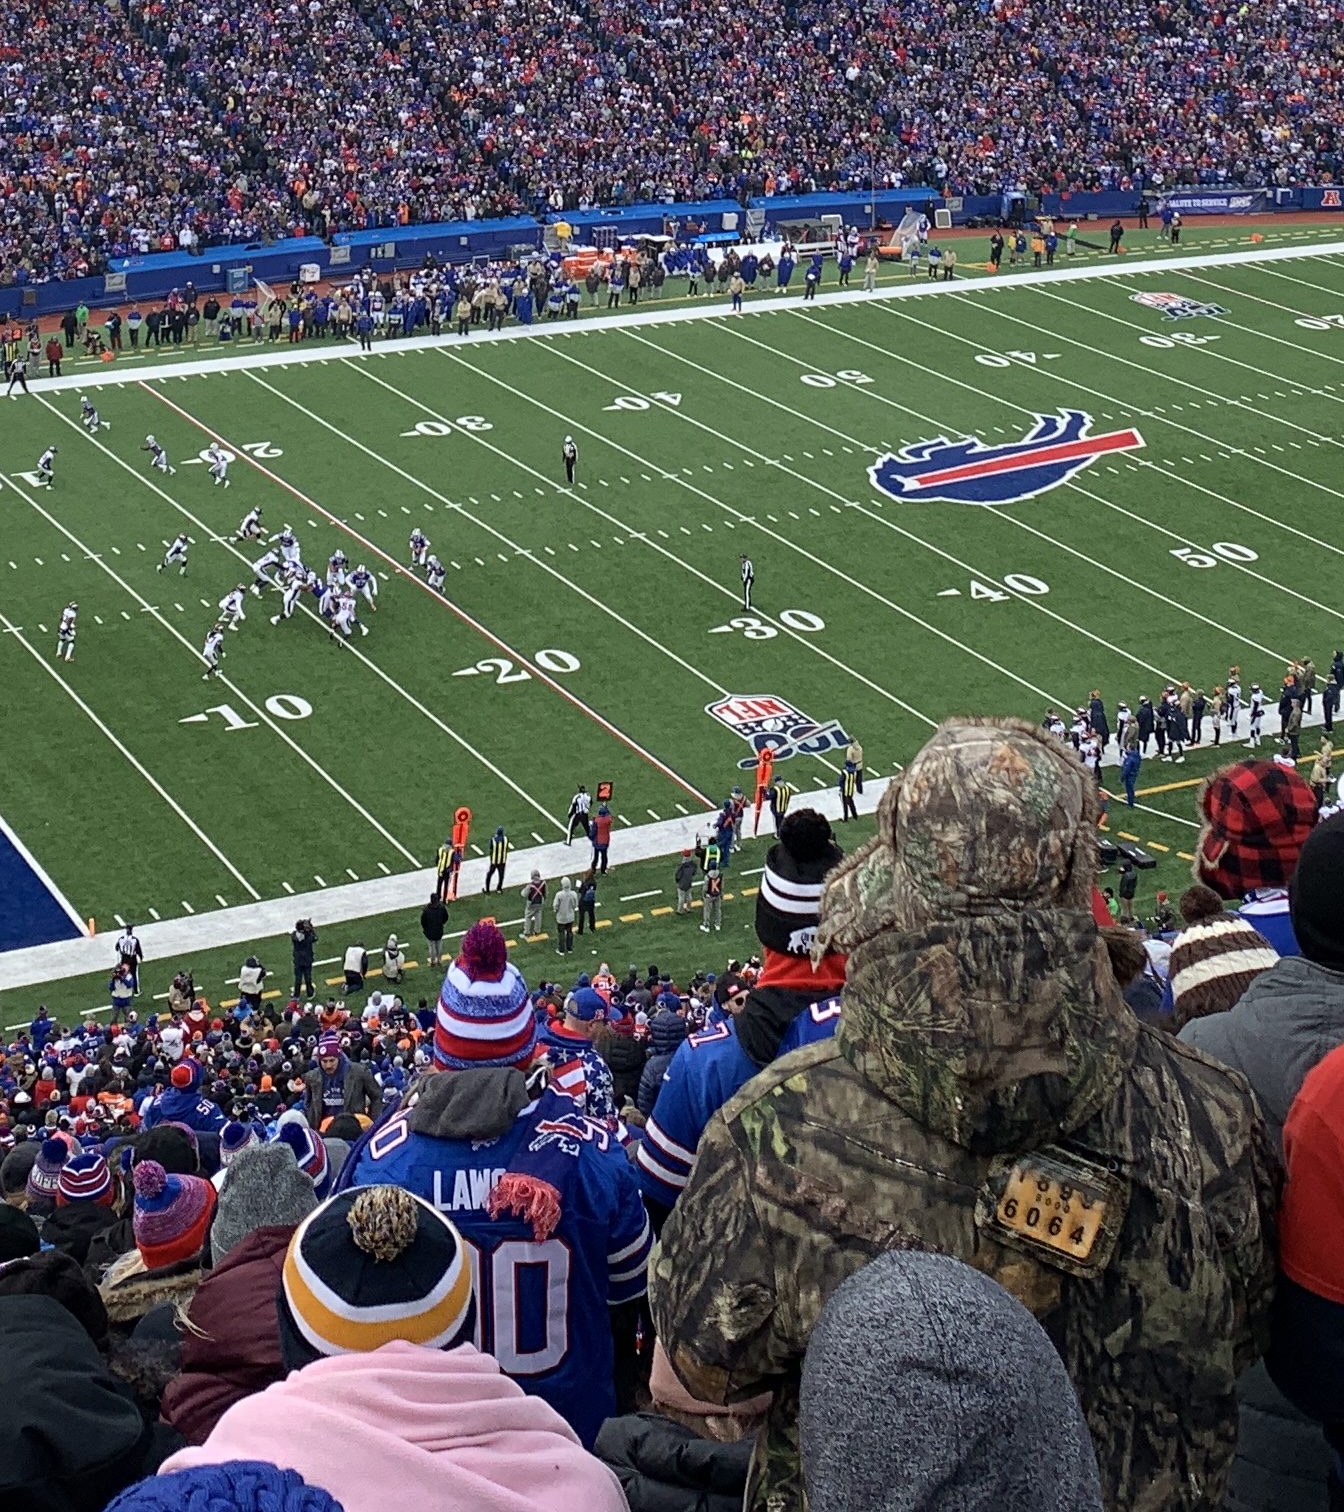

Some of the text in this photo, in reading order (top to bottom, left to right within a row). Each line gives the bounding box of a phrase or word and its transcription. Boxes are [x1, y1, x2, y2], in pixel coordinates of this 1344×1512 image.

[1194, 197, 1201, 208] TO
[1201, 197, 1228, 208] SERVICE
[1138, 330, 1212, 349] 30
[975, 349, 1043, 368] 40
[800, 369, 875, 388] 50
[620, 390, 683, 412] 40
[416, 415, 494, 438] 30
[199, 439, 284, 466] 20
[1170, 540, 1259, 569] 50
[968, 572, 1050, 603] 40
[727, 608, 826, 640] 30
[477, 648, 582, 684] 20
[204, 693, 313, 732] 10
[718, 699, 789, 722] NFL
[196, 1100, 214, 1119] 50
[1004, 1198, 1085, 1245] 6064
[468, 1238, 572, 1376] 0
